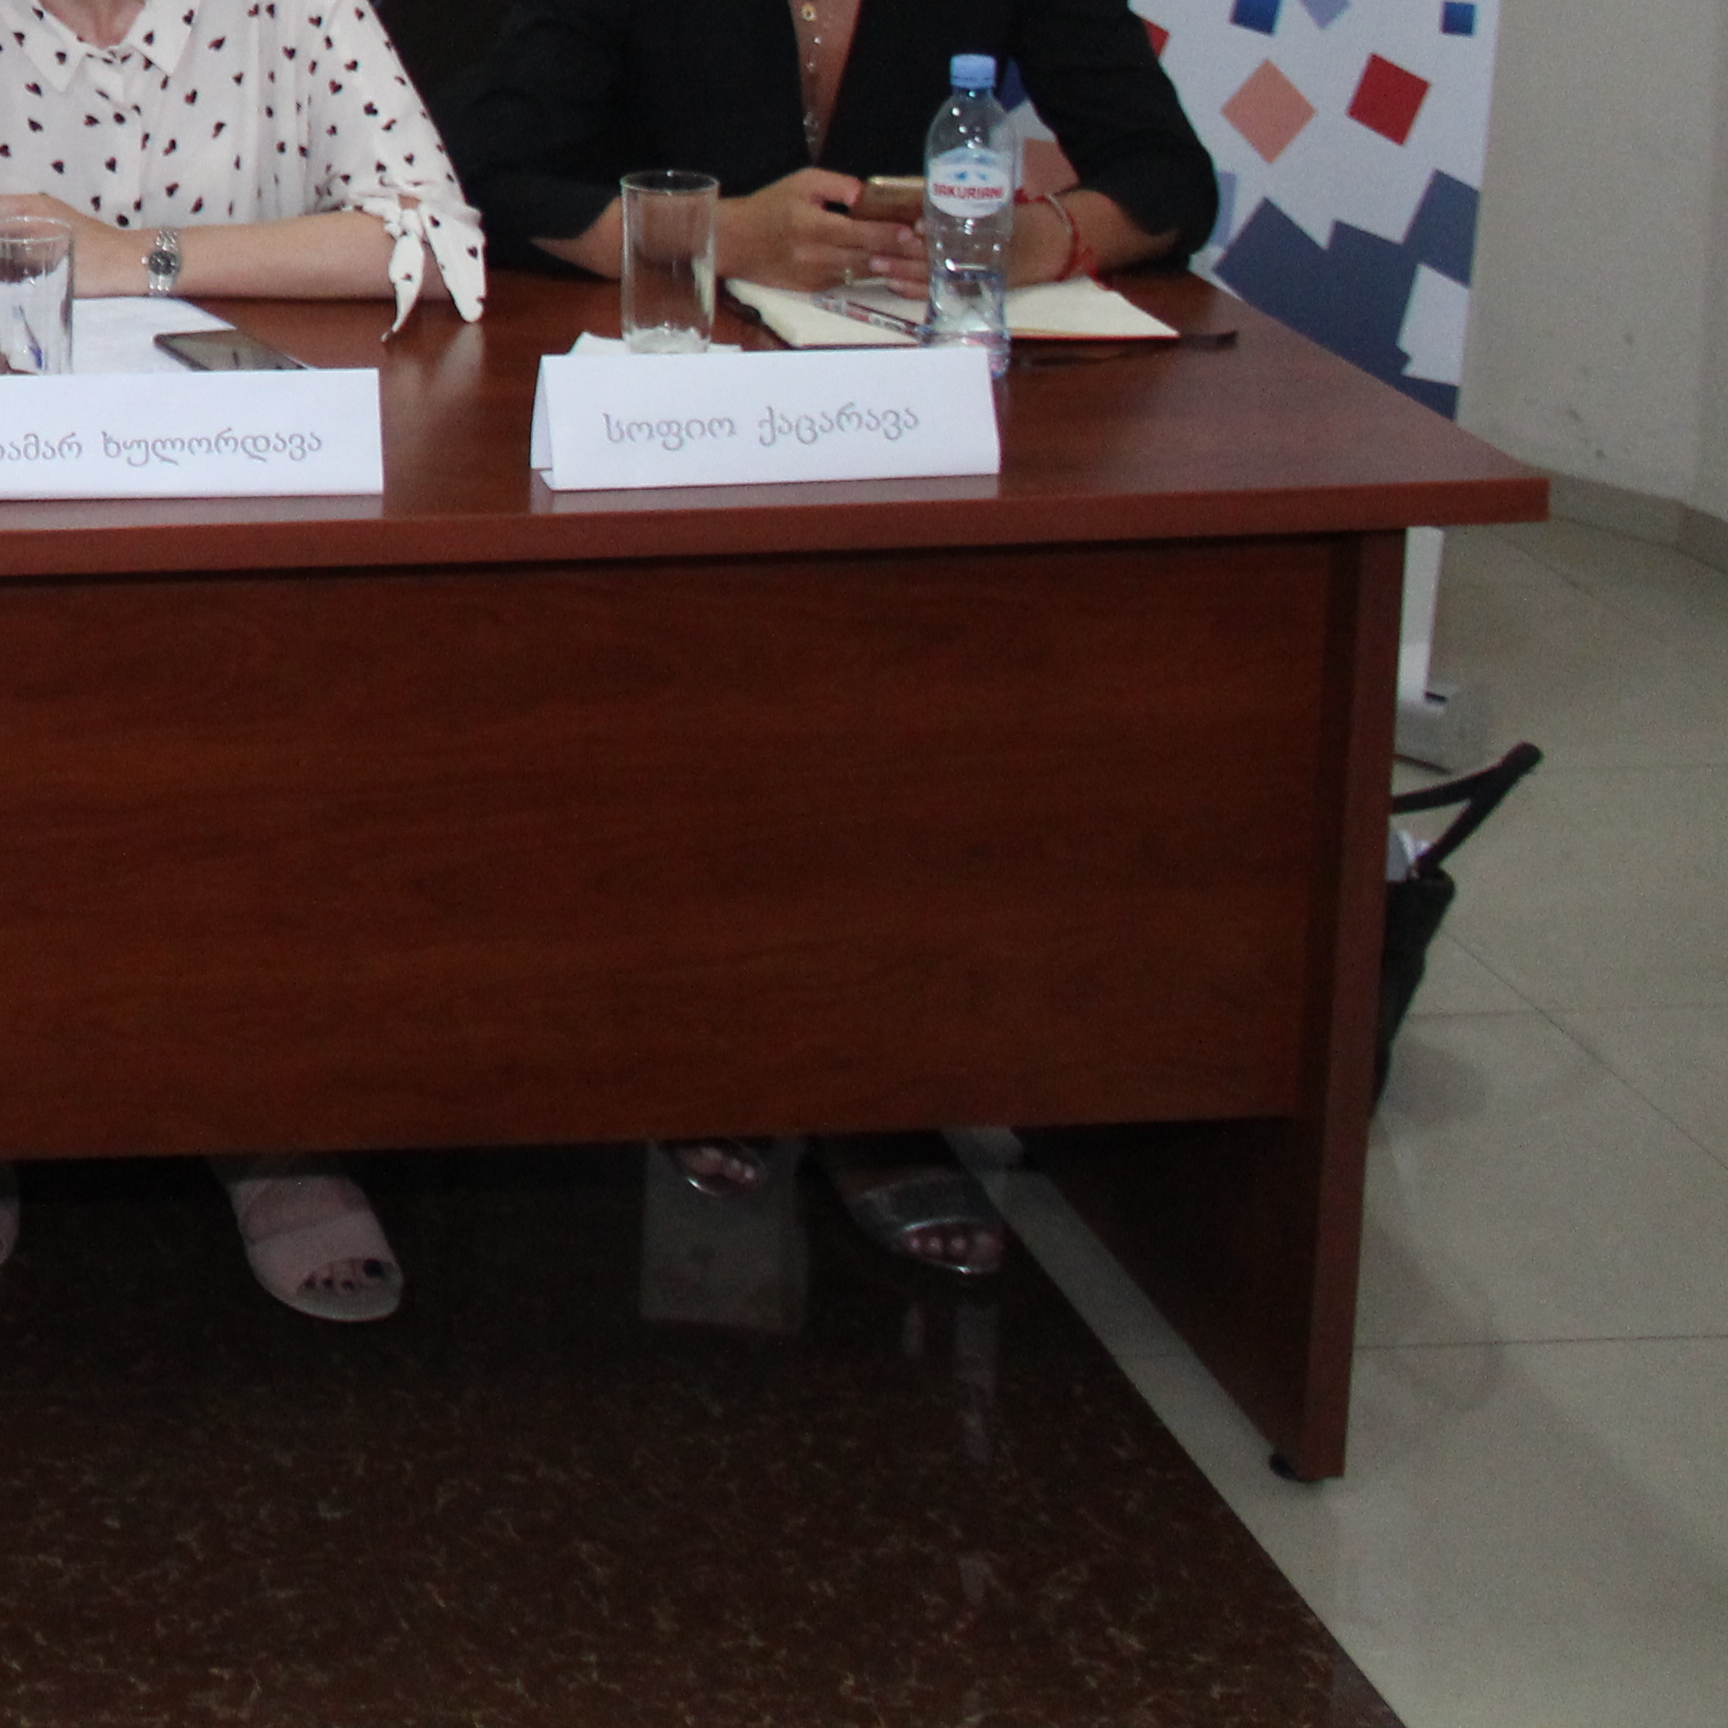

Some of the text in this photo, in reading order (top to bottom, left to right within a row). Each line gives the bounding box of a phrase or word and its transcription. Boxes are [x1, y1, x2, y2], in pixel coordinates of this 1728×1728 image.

[101, 427, 323, 468] ხულორდავა
[602, 401, 920, 452] სოფიო ქაცარავა
